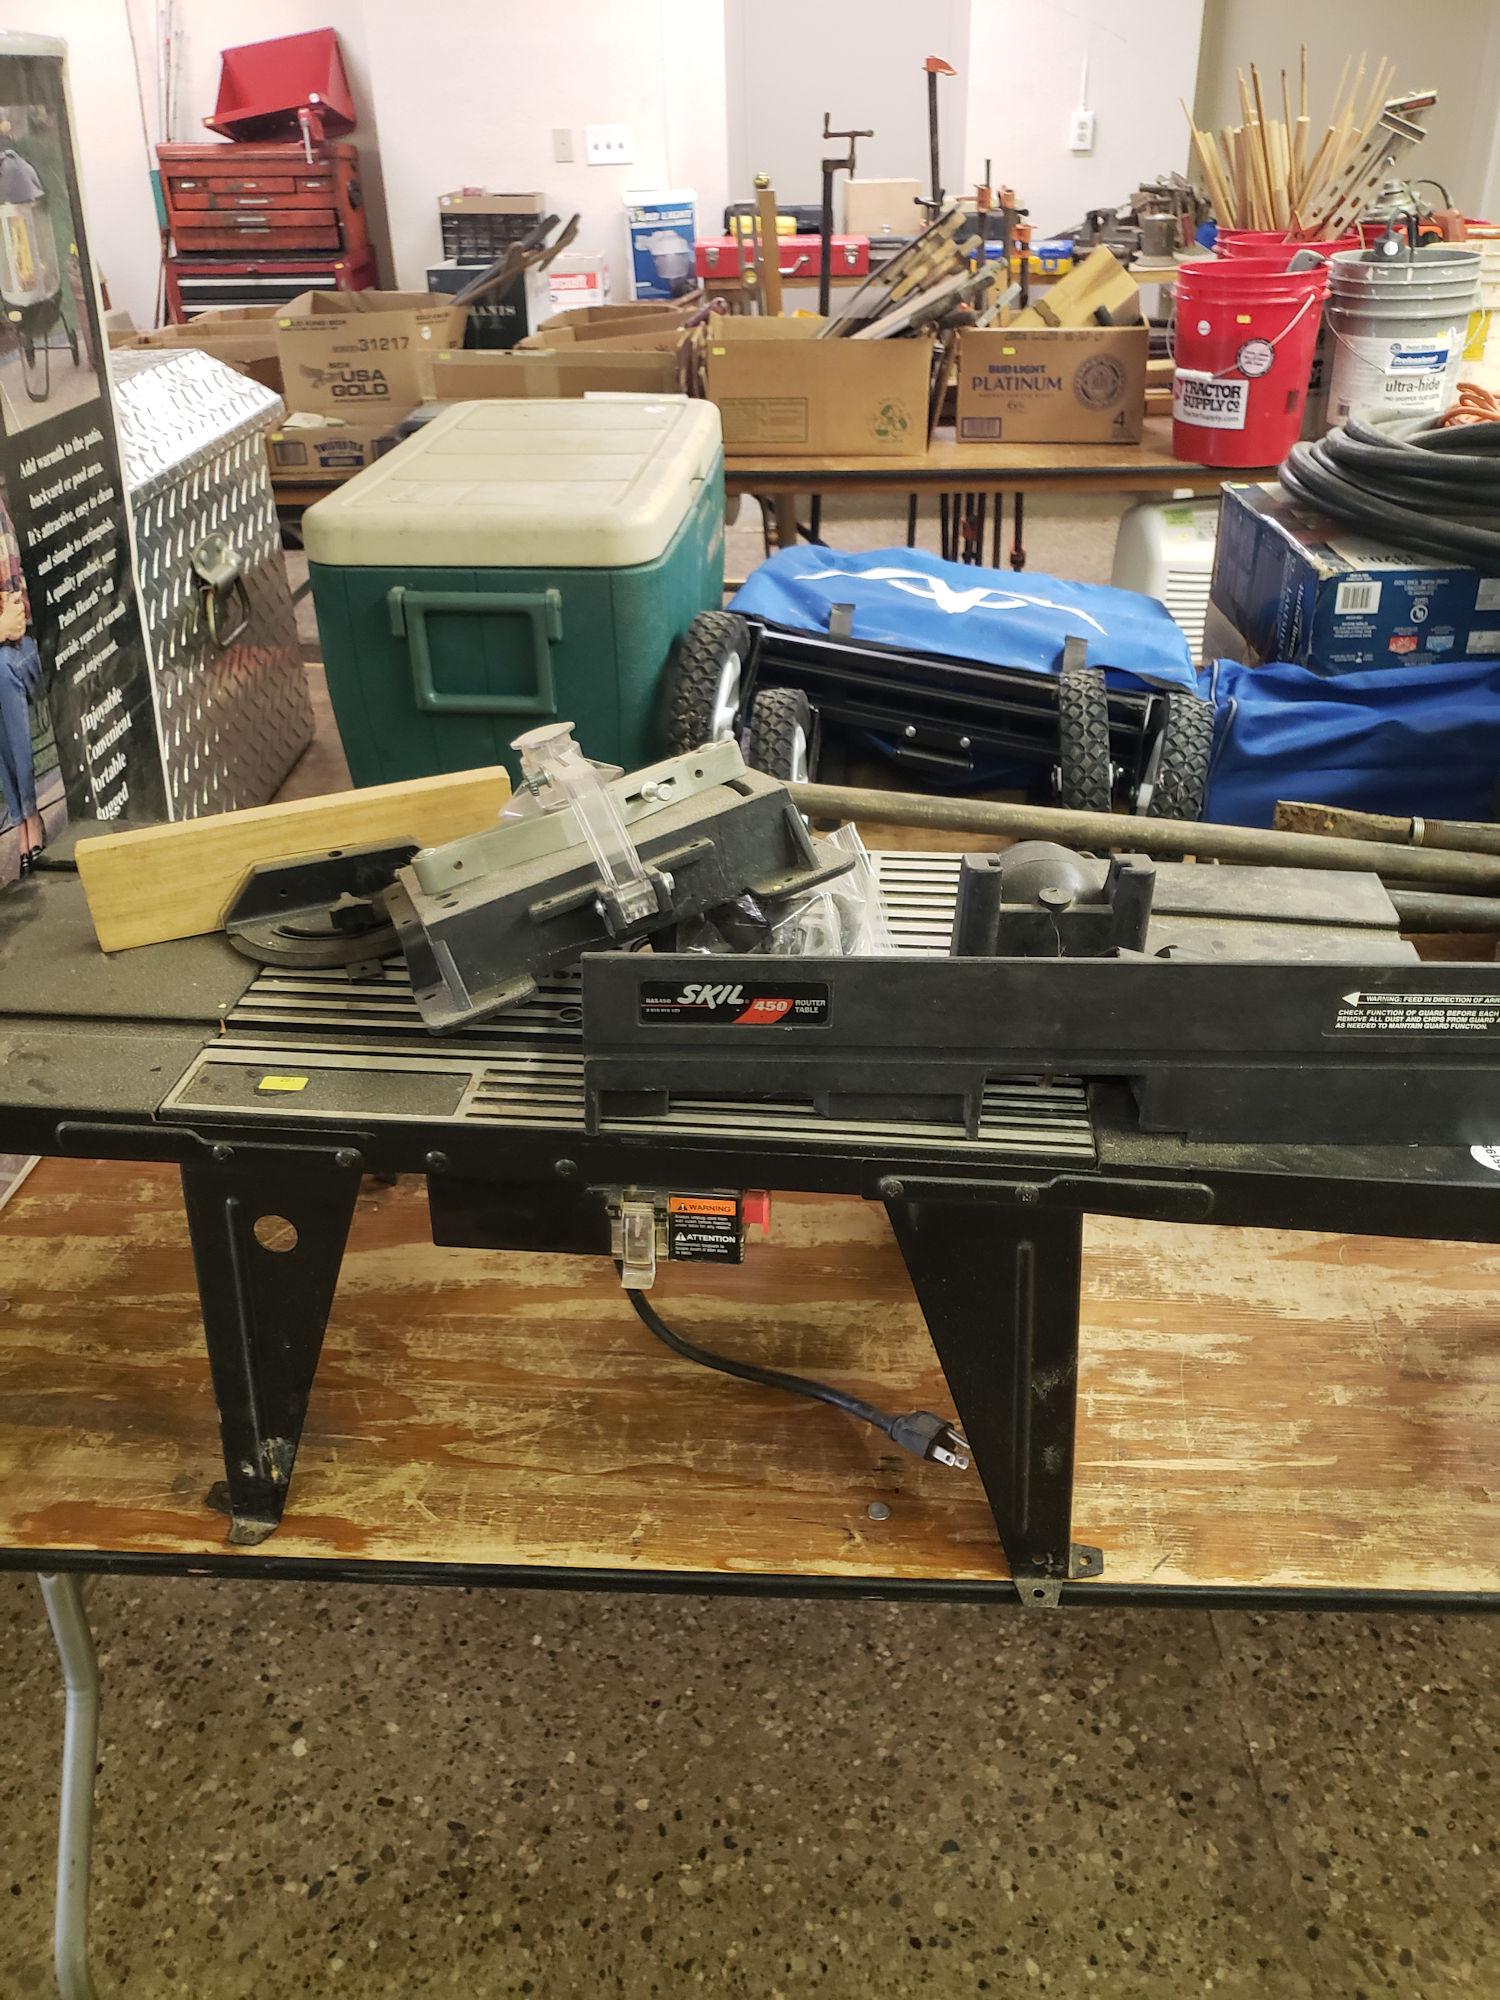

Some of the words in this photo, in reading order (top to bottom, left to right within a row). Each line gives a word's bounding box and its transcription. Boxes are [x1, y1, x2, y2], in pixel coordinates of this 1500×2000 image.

[358, 336, 410, 352] 31217
[340, 369, 386, 383] USA
[988, 365, 1013, 374] BUD
[1014, 364, 1046, 374] LIGHT
[331, 383, 389, 397] GOLD
[972, 376, 1063, 392] PLATINUM
[1183, 380, 1242, 399] TRACTOR
[1384, 377, 1441, 393] ultra-hide
[1183, 394, 1227, 413] SUPPLY
[1112, 411, 1126, 428] 4
[20, 456, 37, 479] Add
[36, 444, 66, 469] warmth
[64, 443, 73, 456] to
[72, 436, 84, 452] the
[28, 478, 64, 510] backyard
[63, 478, 72, 491] or
[72, 466, 87, 490] pool
[75, 501, 89, 518] easy
[89, 496, 98, 509] to
[97, 487, 115, 505] clean
[37, 554, 53, 576] and
[52, 542, 75, 567] simple
[73, 539, 83, 552] to
[46, 589, 54, 606] A
[53, 576, 77, 603] quality
[54, 639, 80, 671] provide
[96, 616, 104, 633] of
[102, 600, 126, 627] warmth
[73, 663, 87, 685] and
[80, 686, 123, 736] Enjoyable
[85, 711, 132, 765] Convenient
[91, 752, 127, 796] Portable
[676, 984, 745, 1009] SKIL
[754, 1000, 788, 1012] 450
[795, 999, 826, 1007] ROUTER
[1433, 996, 1472, 1004] DIRECTION
[795, 1006, 819, 1014] TABLE
[1423, 1022, 1449, 1030] GUARD
[688, 1204, 732, 1213] WARNING
[686, 1233, 736, 1244] ATTENTION
